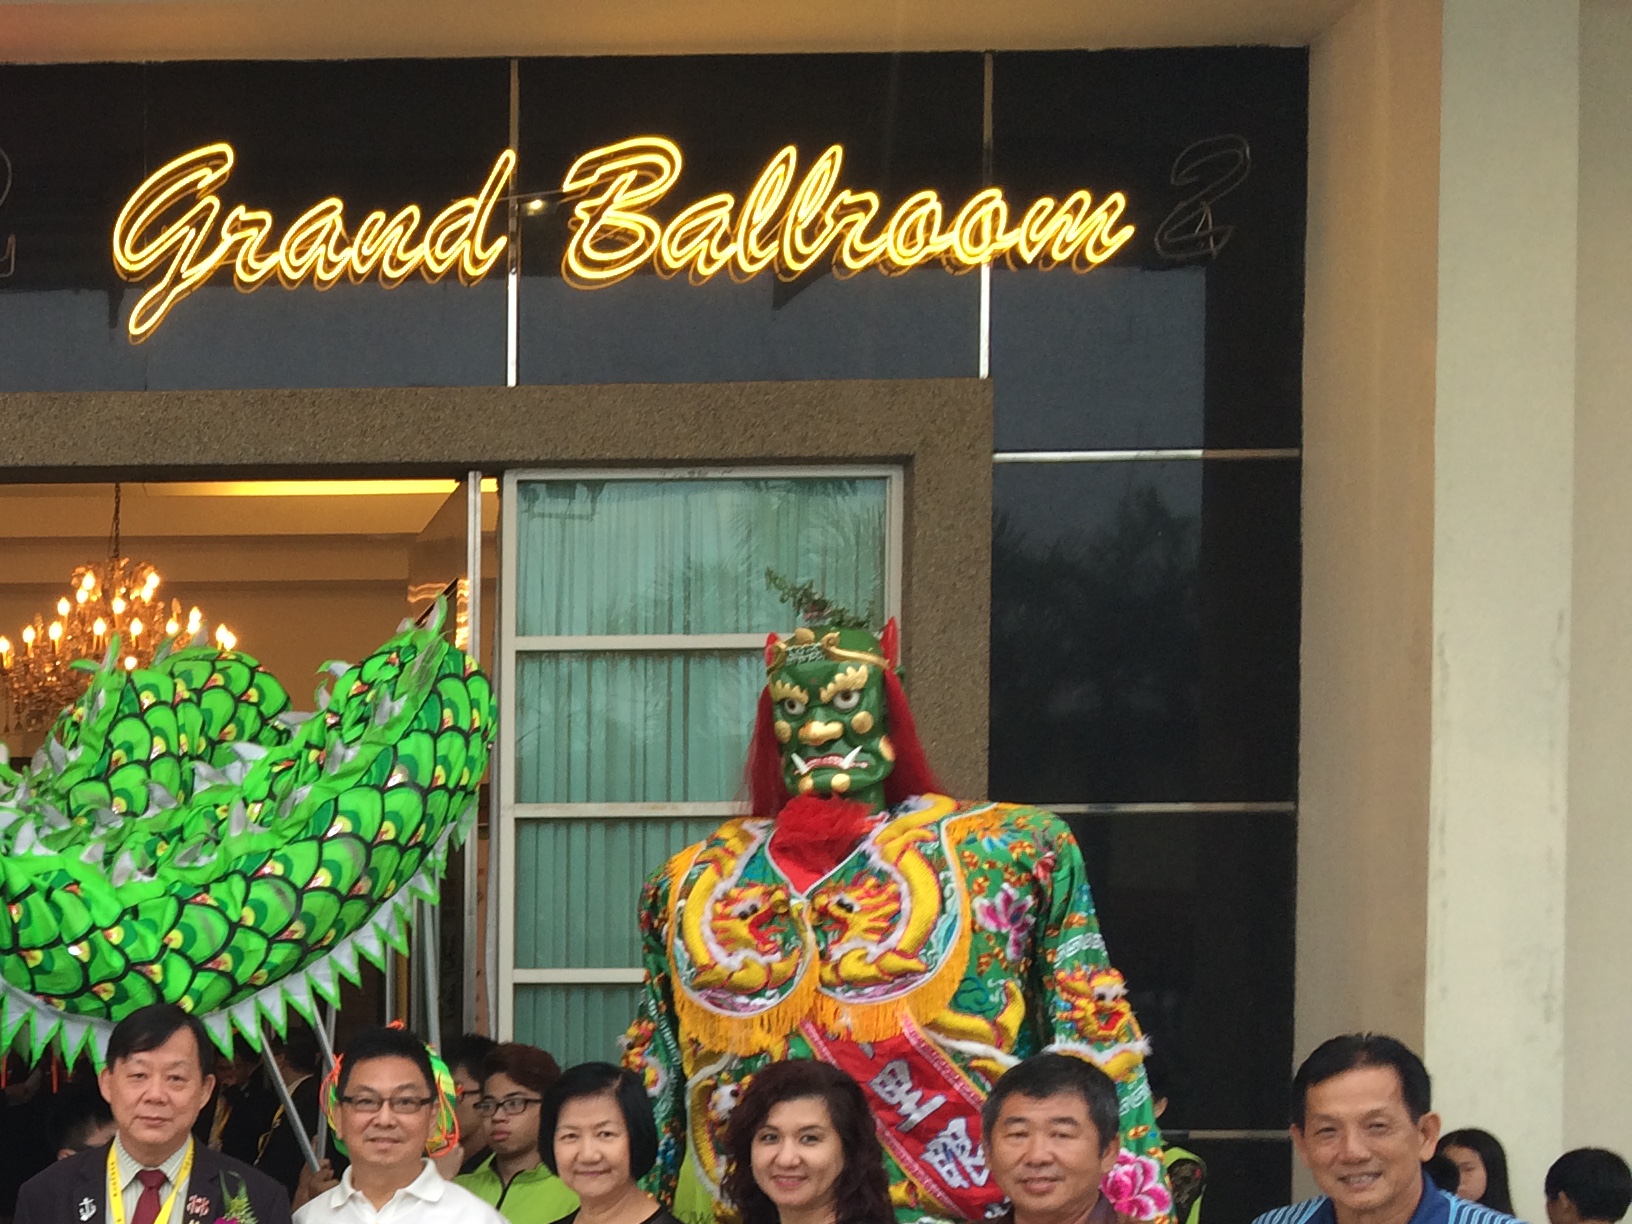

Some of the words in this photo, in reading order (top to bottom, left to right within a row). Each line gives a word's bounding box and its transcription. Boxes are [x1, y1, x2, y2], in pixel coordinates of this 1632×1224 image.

[112, 142, 516, 340] Grand
[564, 136, 1136, 283] Ballroom
[1154, 134, 1252, 260] 2
